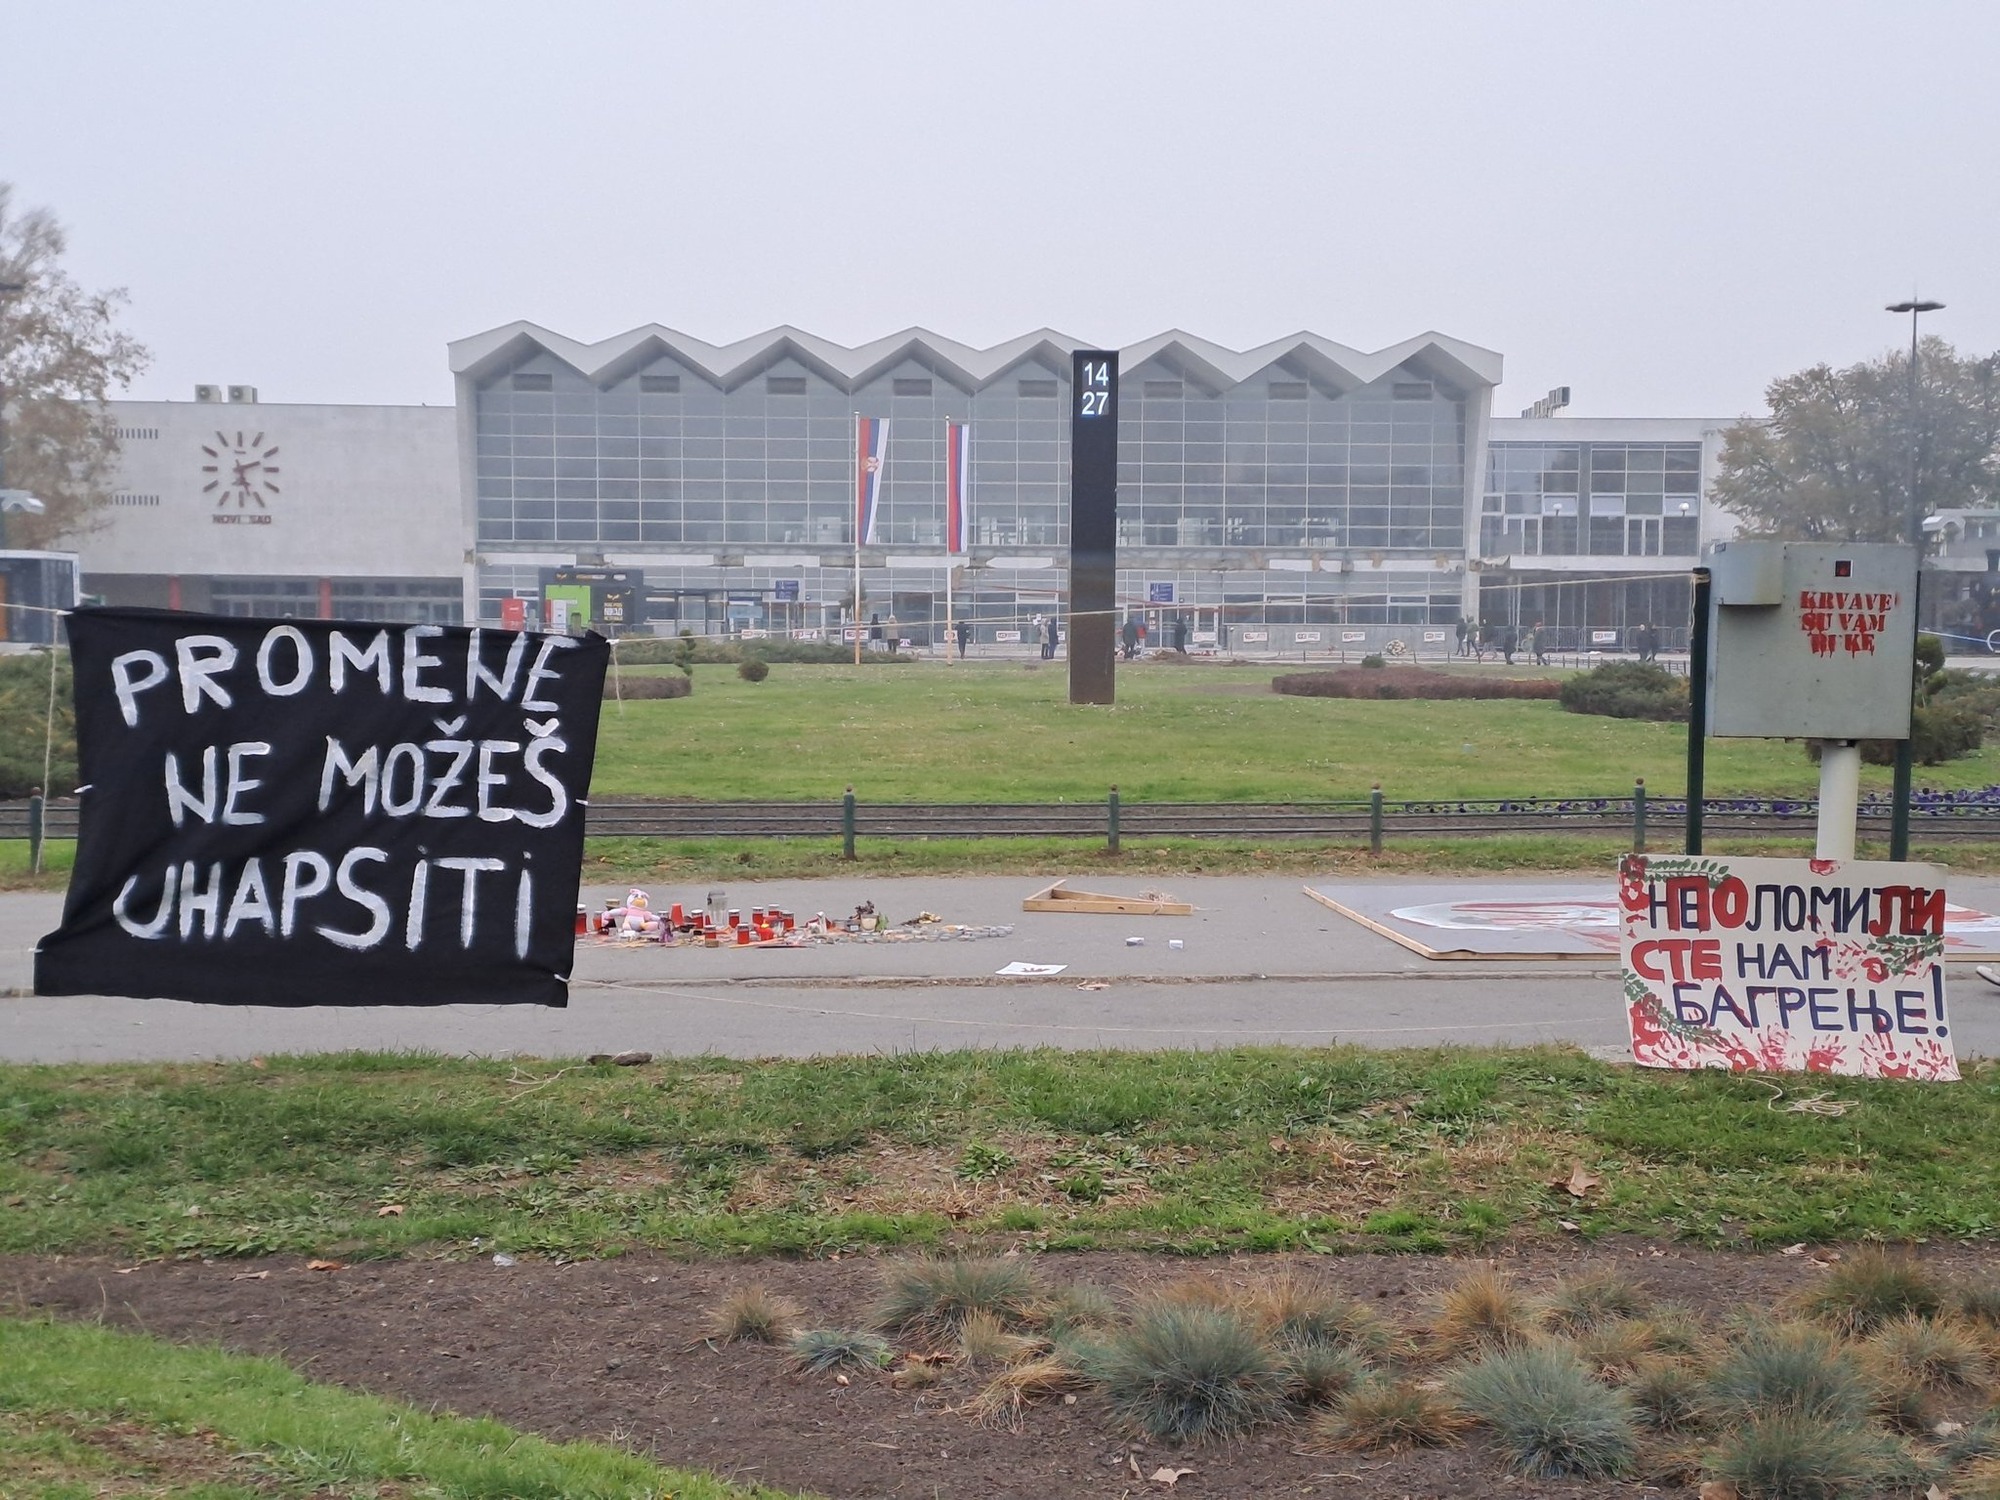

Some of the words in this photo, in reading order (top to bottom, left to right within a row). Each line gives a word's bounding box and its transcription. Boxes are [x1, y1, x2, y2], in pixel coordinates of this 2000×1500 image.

[1084, 362, 1109, 386] 14
[1081, 391, 1109, 415] 27
[212, 514, 241, 524] NOVI
[249, 514, 272, 525] SAD
[1800, 591, 1892, 612] KRVAVE
[1801, 612, 1833, 631] SU
[1838, 613, 1886, 632] VAM
[111, 625, 579, 727] PROMENE
[166, 742, 273, 827] NE
[318, 715, 567, 828] MOŽEŠ
[1631, 939, 1723, 983] СТЕ
[1737, 943, 1830, 980] НАМ
[1673, 964, 1948, 1038] БАГРЕЊЕ!
